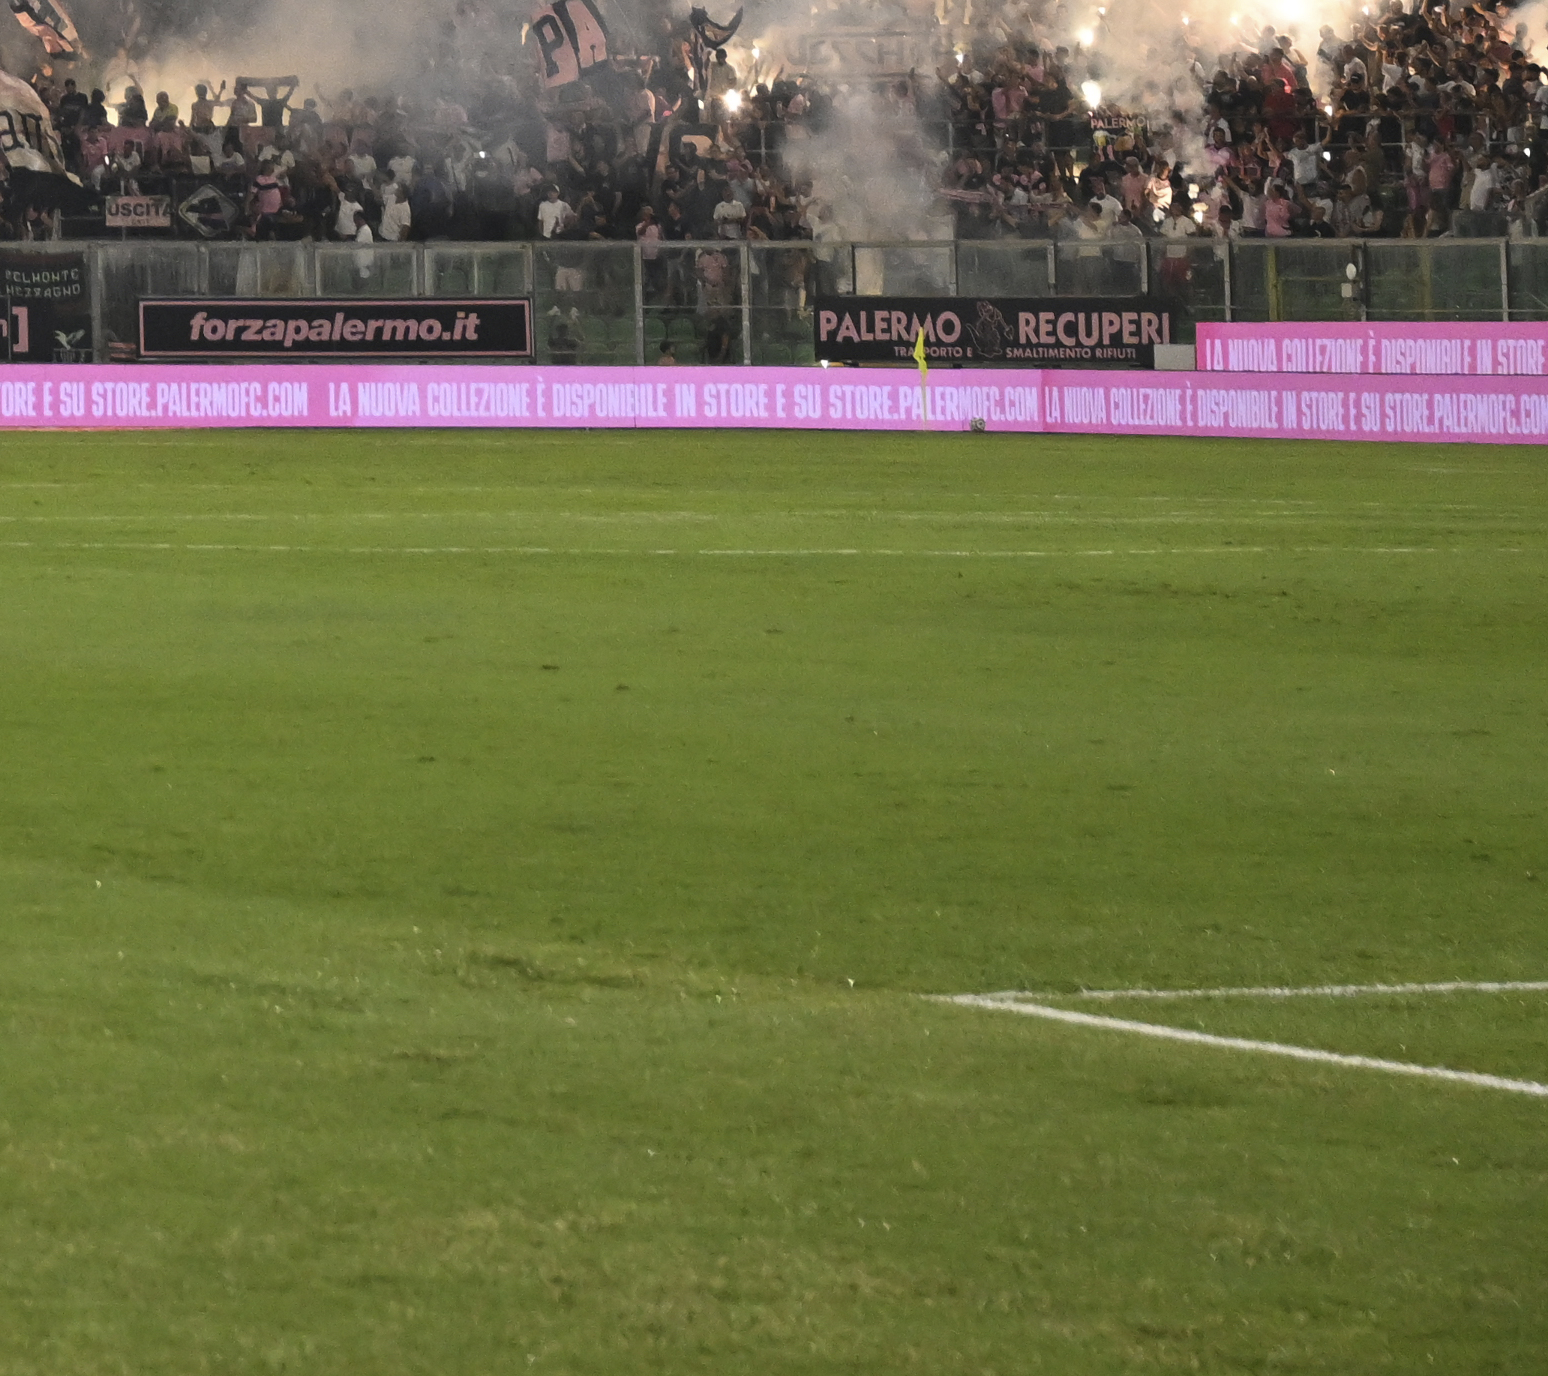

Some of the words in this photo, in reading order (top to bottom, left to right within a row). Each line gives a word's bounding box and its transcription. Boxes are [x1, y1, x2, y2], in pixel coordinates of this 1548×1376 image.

[108, 201, 172, 217] USCITA
[189, 311, 481, 347] forzapalermo.it
[819, 310, 962, 344] PALERMO
[1017, 311, 1171, 347] RECUPERI
[894, 347, 964, 358] TRAPORTO
[966, 347, 974, 358] E
[1005, 347, 1092, 359] SMALTIMENTO
[1094, 347, 1137, 359] RIFIUTI
[1228, 339, 1278, 372] NUOVA
[1476, 339, 1492, 375] IN
[1497, 339, 1546, 375] STORE
[43, 381, 53, 417] E
[59, 381, 86, 417] SU
[91, 381, 309, 417] STORE.PALERMOFC.COM
[329, 381, 352, 417] LA
[357, 381, 421, 417] NUOVA
[426, 381, 530, 418] COLLEZIONE
[536, 375, 546, 418] È
[552, 382, 668, 418] DISPONIBILE
[674, 383, 697, 418] IN
[703, 383, 769, 419] STORE
[775, 383, 786, 419] E
[794, 383, 822, 420] SU
[828, 384, 1039, 422] STORE.PALERMOFC.COM
[1044, 386, 1062, 425] LA
[1064, 386, 1107, 426] NUOVA
[1110, 386, 1183, 428] COLLEZIONE
[1185, 380, 1194, 428] È
[1197, 388, 1279, 430] DISPONIBILE
[1282, 390, 1297, 430] IN
[1302, 390, 1345, 431] STORE
[1349, 391, 1358, 432] E
[1360, 391, 1381, 433] SU
